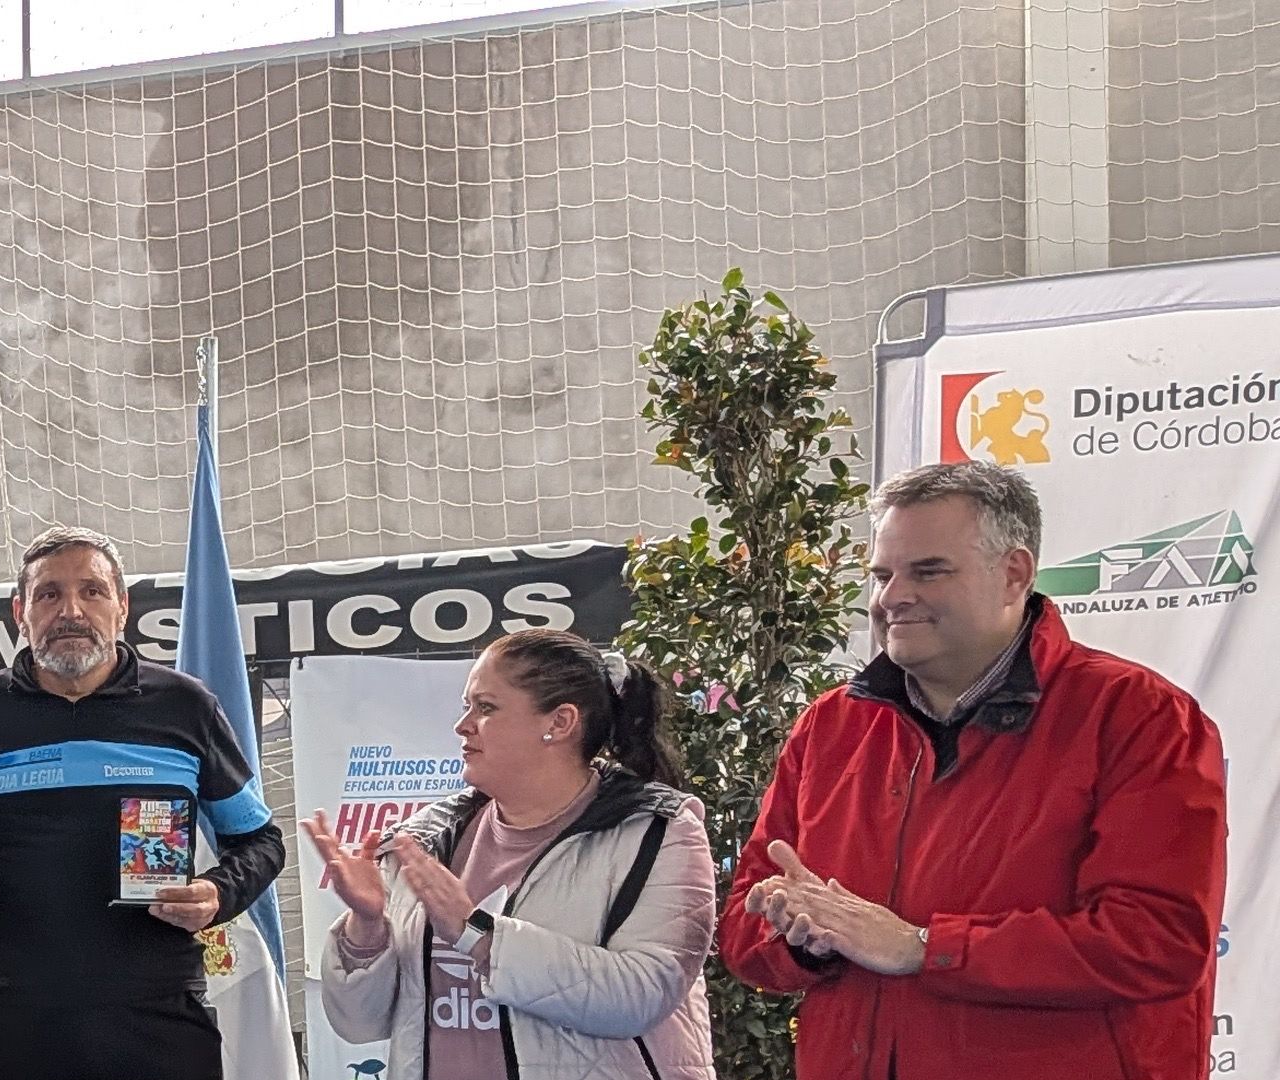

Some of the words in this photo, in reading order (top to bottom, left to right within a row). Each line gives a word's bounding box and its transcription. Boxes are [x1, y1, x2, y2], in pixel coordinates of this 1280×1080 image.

[1073, 426, 1119, 456] de
[1157, 596, 1179, 610] DE
[349, 745, 392, 760] NUEVO
[347, 759, 437, 777] MULTIUSOS
[439, 758, 464, 775] CO
[21, 767, 65, 787] LEGUA
[343, 780, 395, 793] EFICACIA
[397, 779, 422, 791] CON
[424, 778, 465, 791] ESPUM
